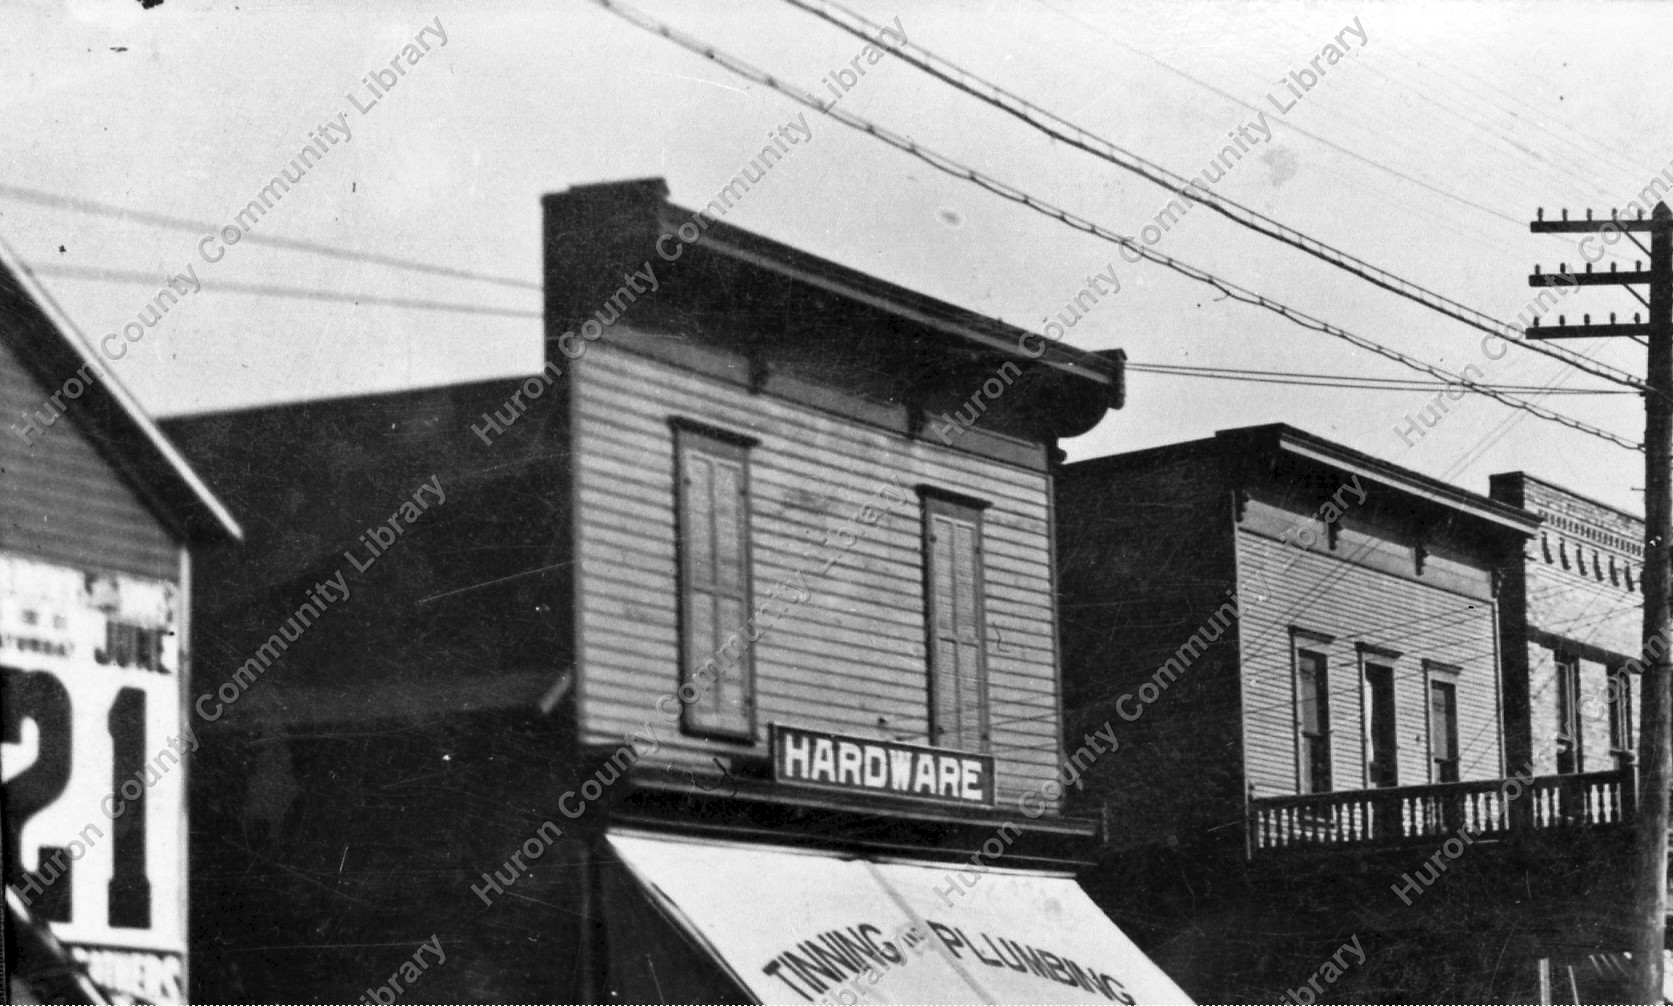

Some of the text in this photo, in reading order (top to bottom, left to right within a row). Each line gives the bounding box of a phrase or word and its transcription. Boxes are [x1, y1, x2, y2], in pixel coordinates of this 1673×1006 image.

[94, 618, 174, 675] JUNE
[0, 665, 152, 930] 21
[782, 734, 984, 801] HARDWARE
[762, 922, 904, 1003] TINNING
